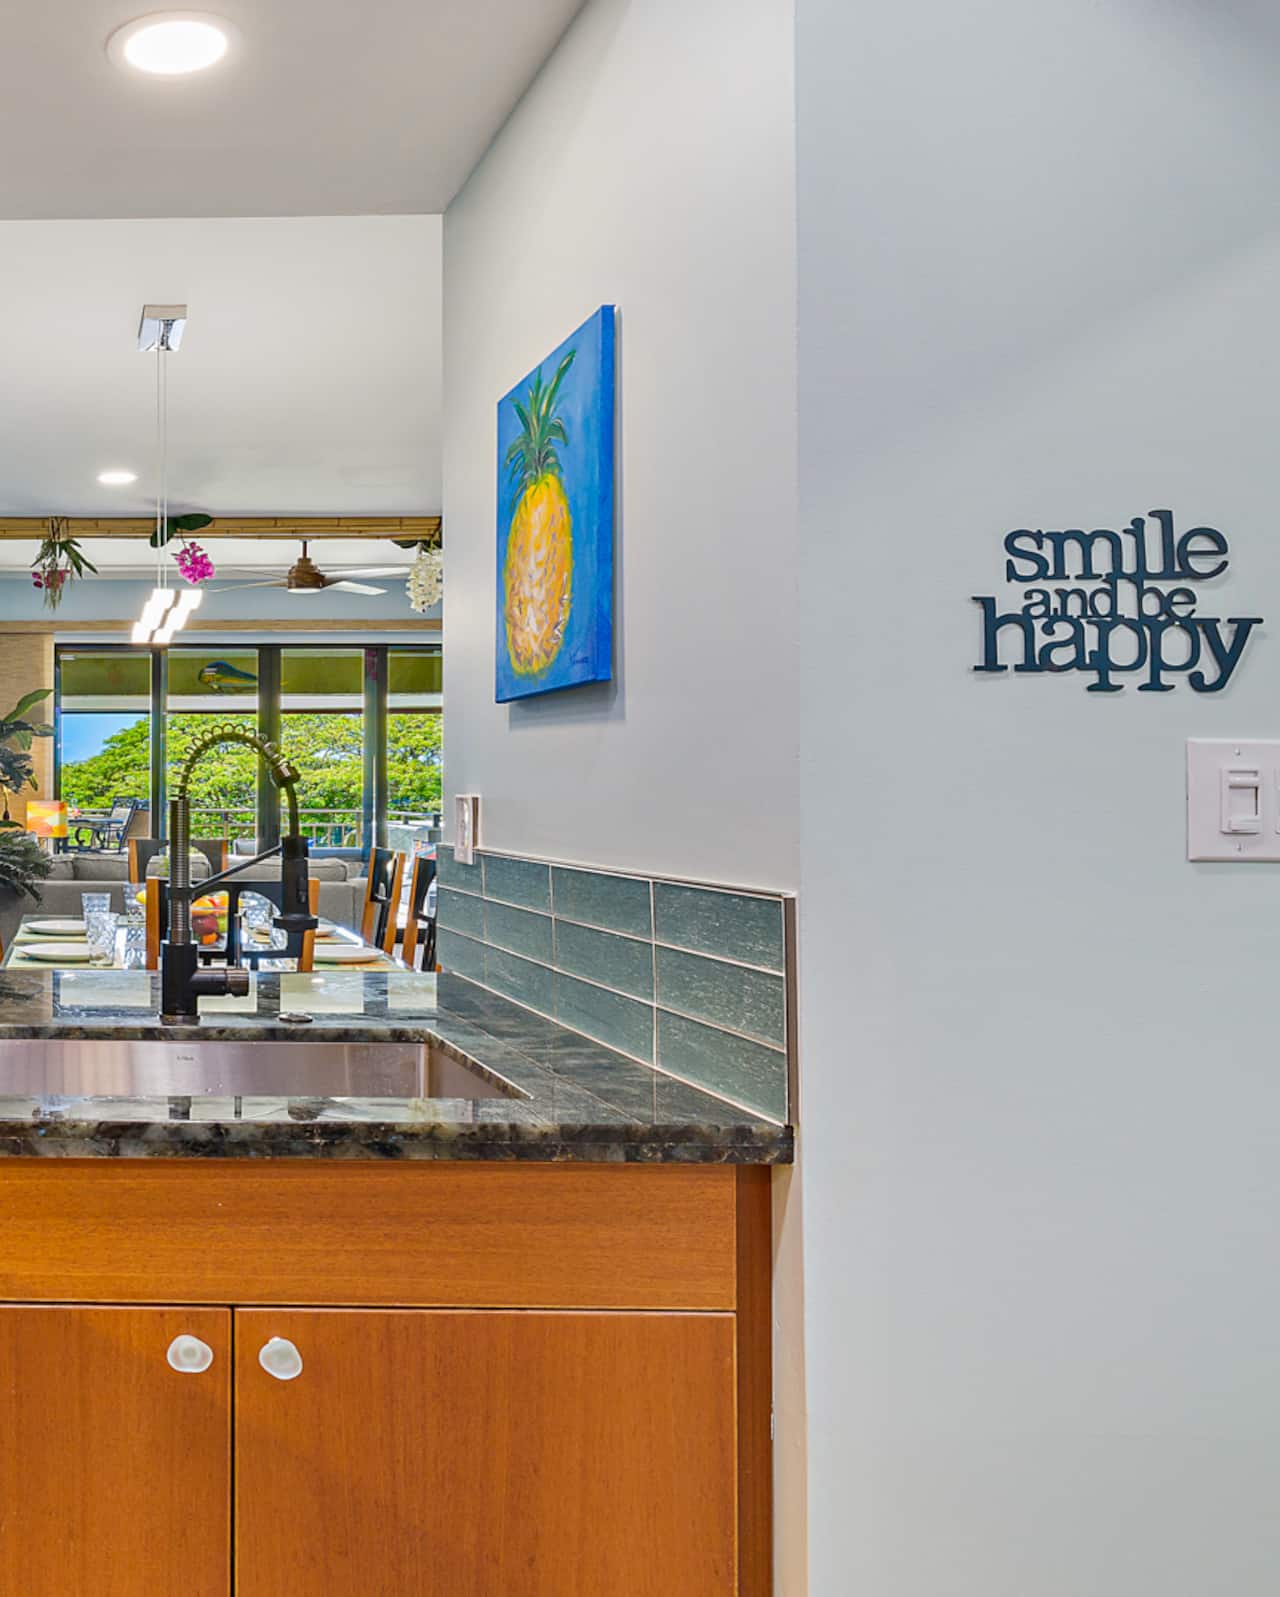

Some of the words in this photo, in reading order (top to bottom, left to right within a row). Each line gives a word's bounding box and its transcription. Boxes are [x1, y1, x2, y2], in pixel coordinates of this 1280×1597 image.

[1003, 509, 1230, 583] smile
[1021, 574, 1125, 620] and
[1127, 574, 1198, 621] be
[970, 596, 1264, 693] happy
